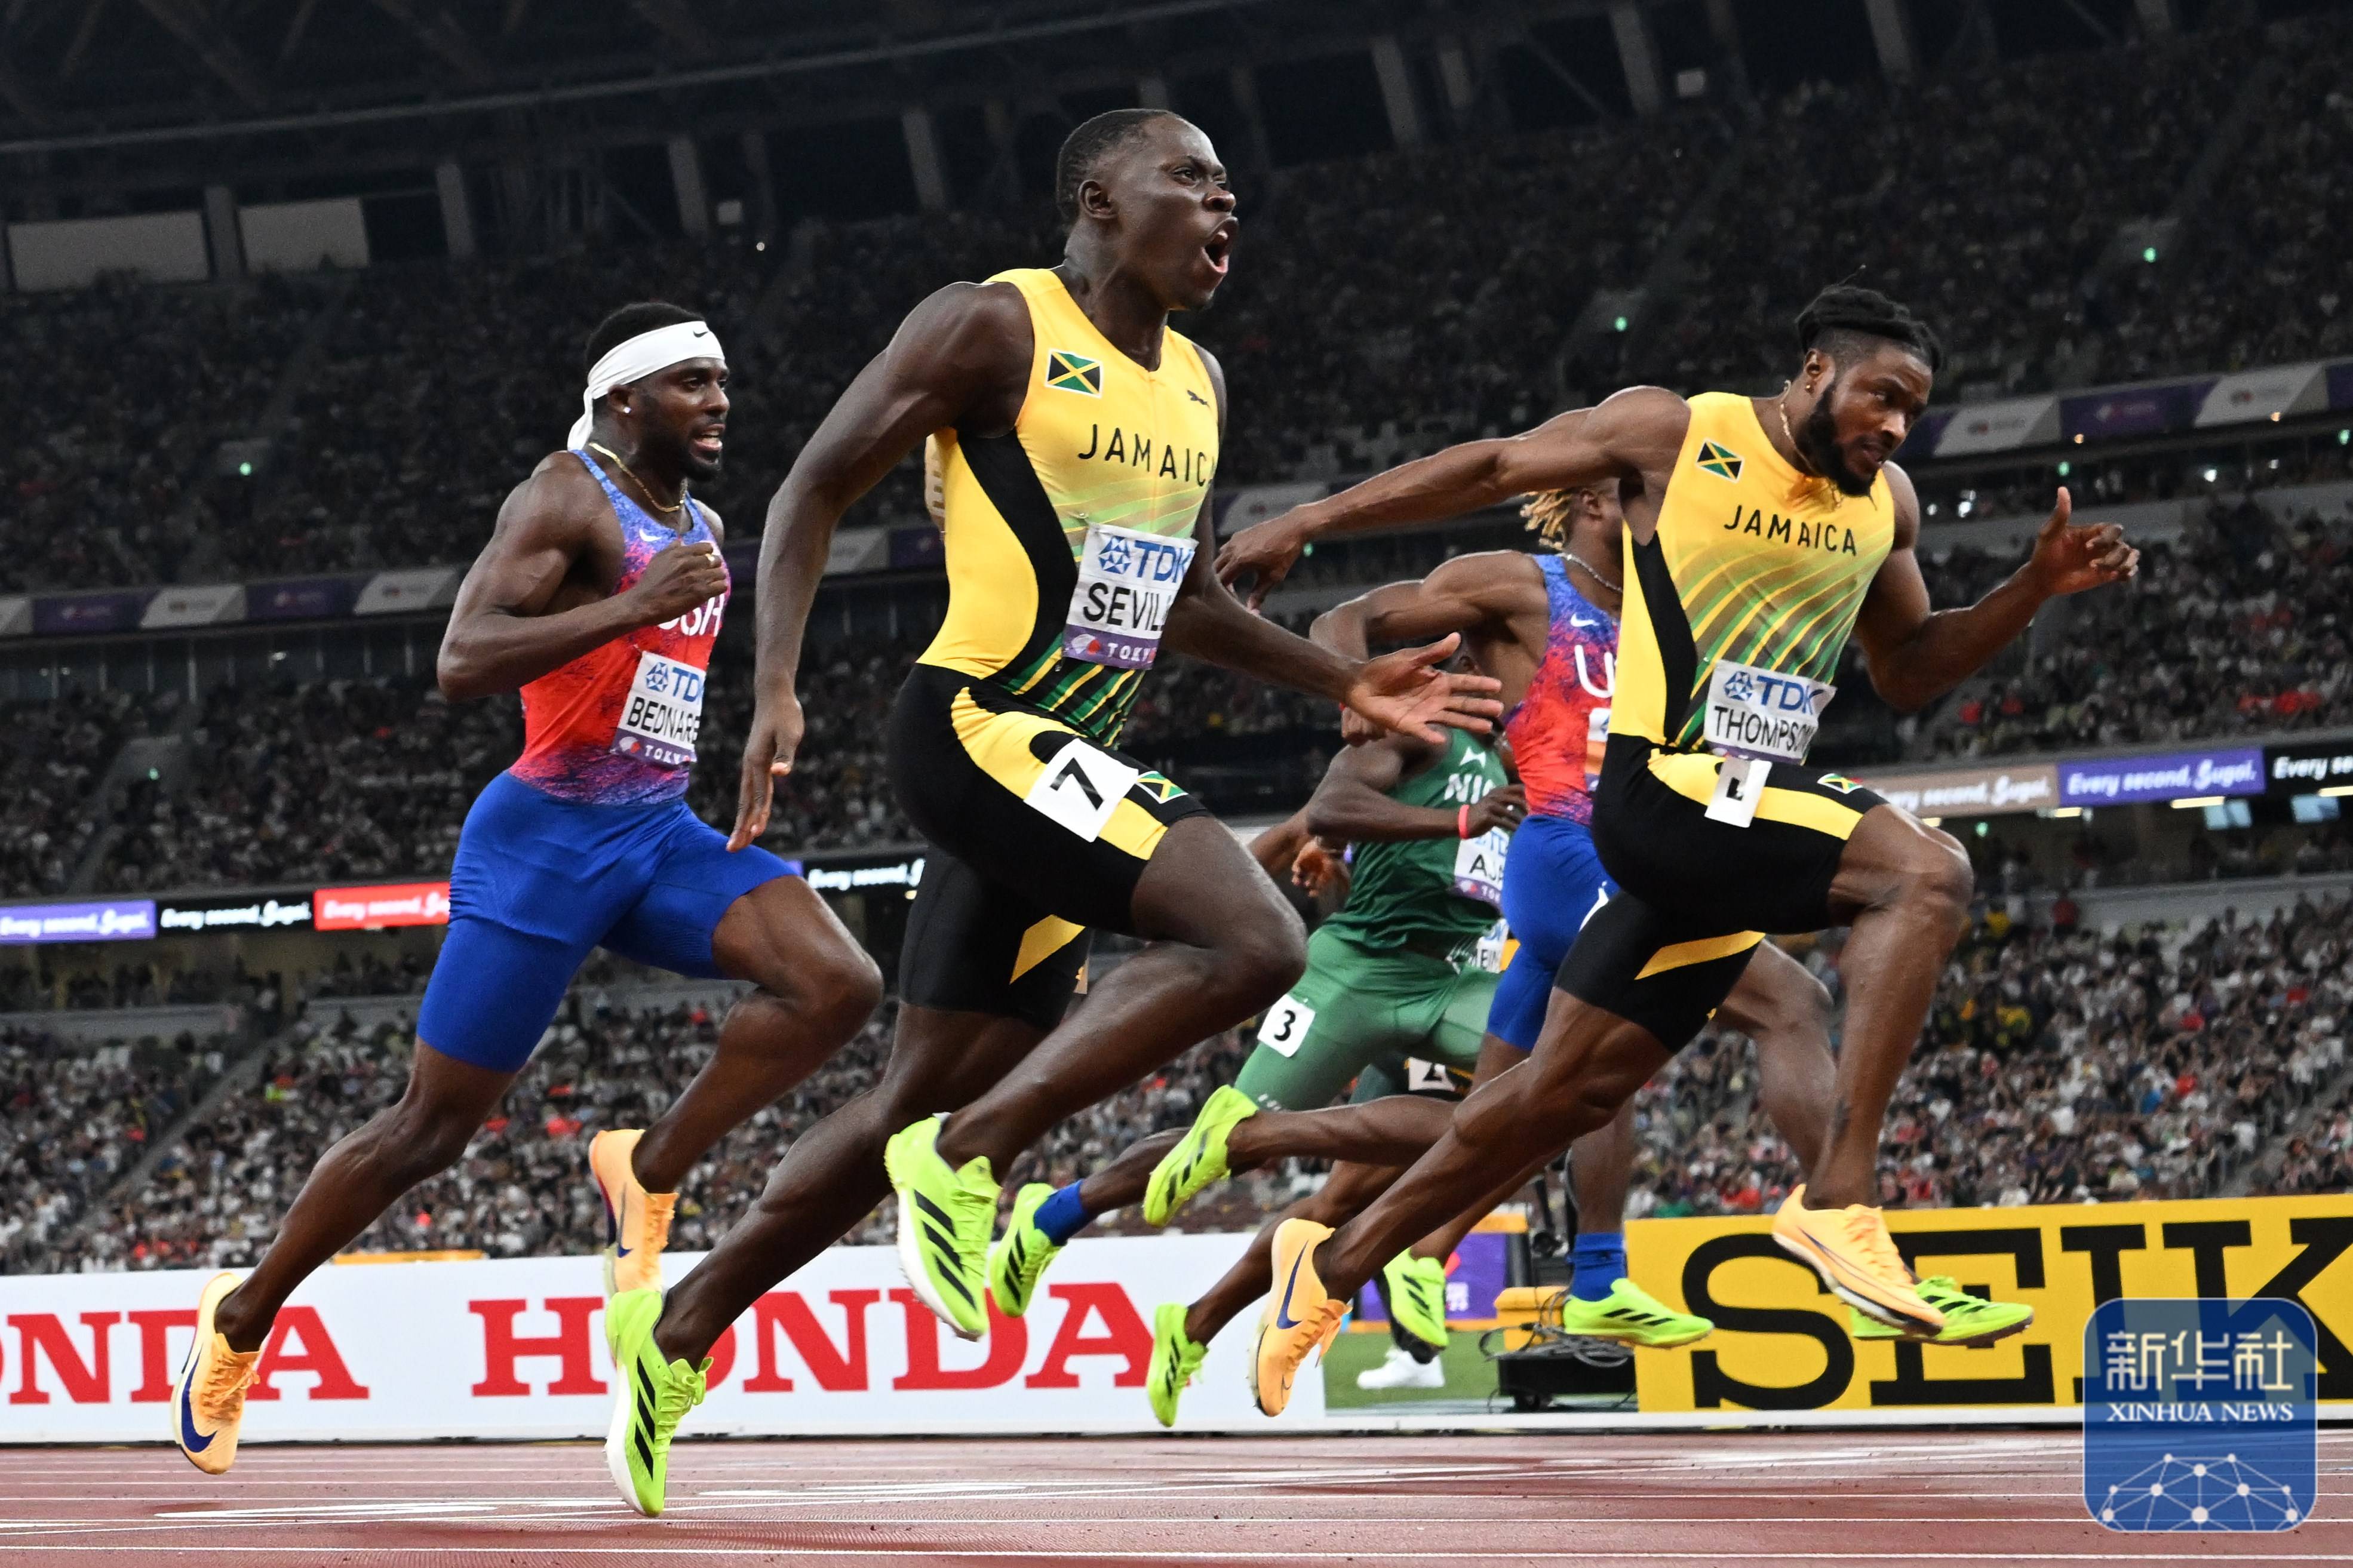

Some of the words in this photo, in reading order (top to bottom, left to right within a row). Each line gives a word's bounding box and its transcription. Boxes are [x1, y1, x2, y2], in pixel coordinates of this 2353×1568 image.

[1077, 423, 1216, 487] JAMAIC
[1724, 505, 1857, 557] JAMAICA
[1134, 539, 1195, 583] TDK
[672, 666, 705, 703] TD
[1756, 675, 1825, 715] TDK
[1049, 757, 1105, 811] 7
[2068, 772, 2119, 797] Every
[2272, 756, 2329, 781] Every
[1274, 1010, 1296, 1041] 3
